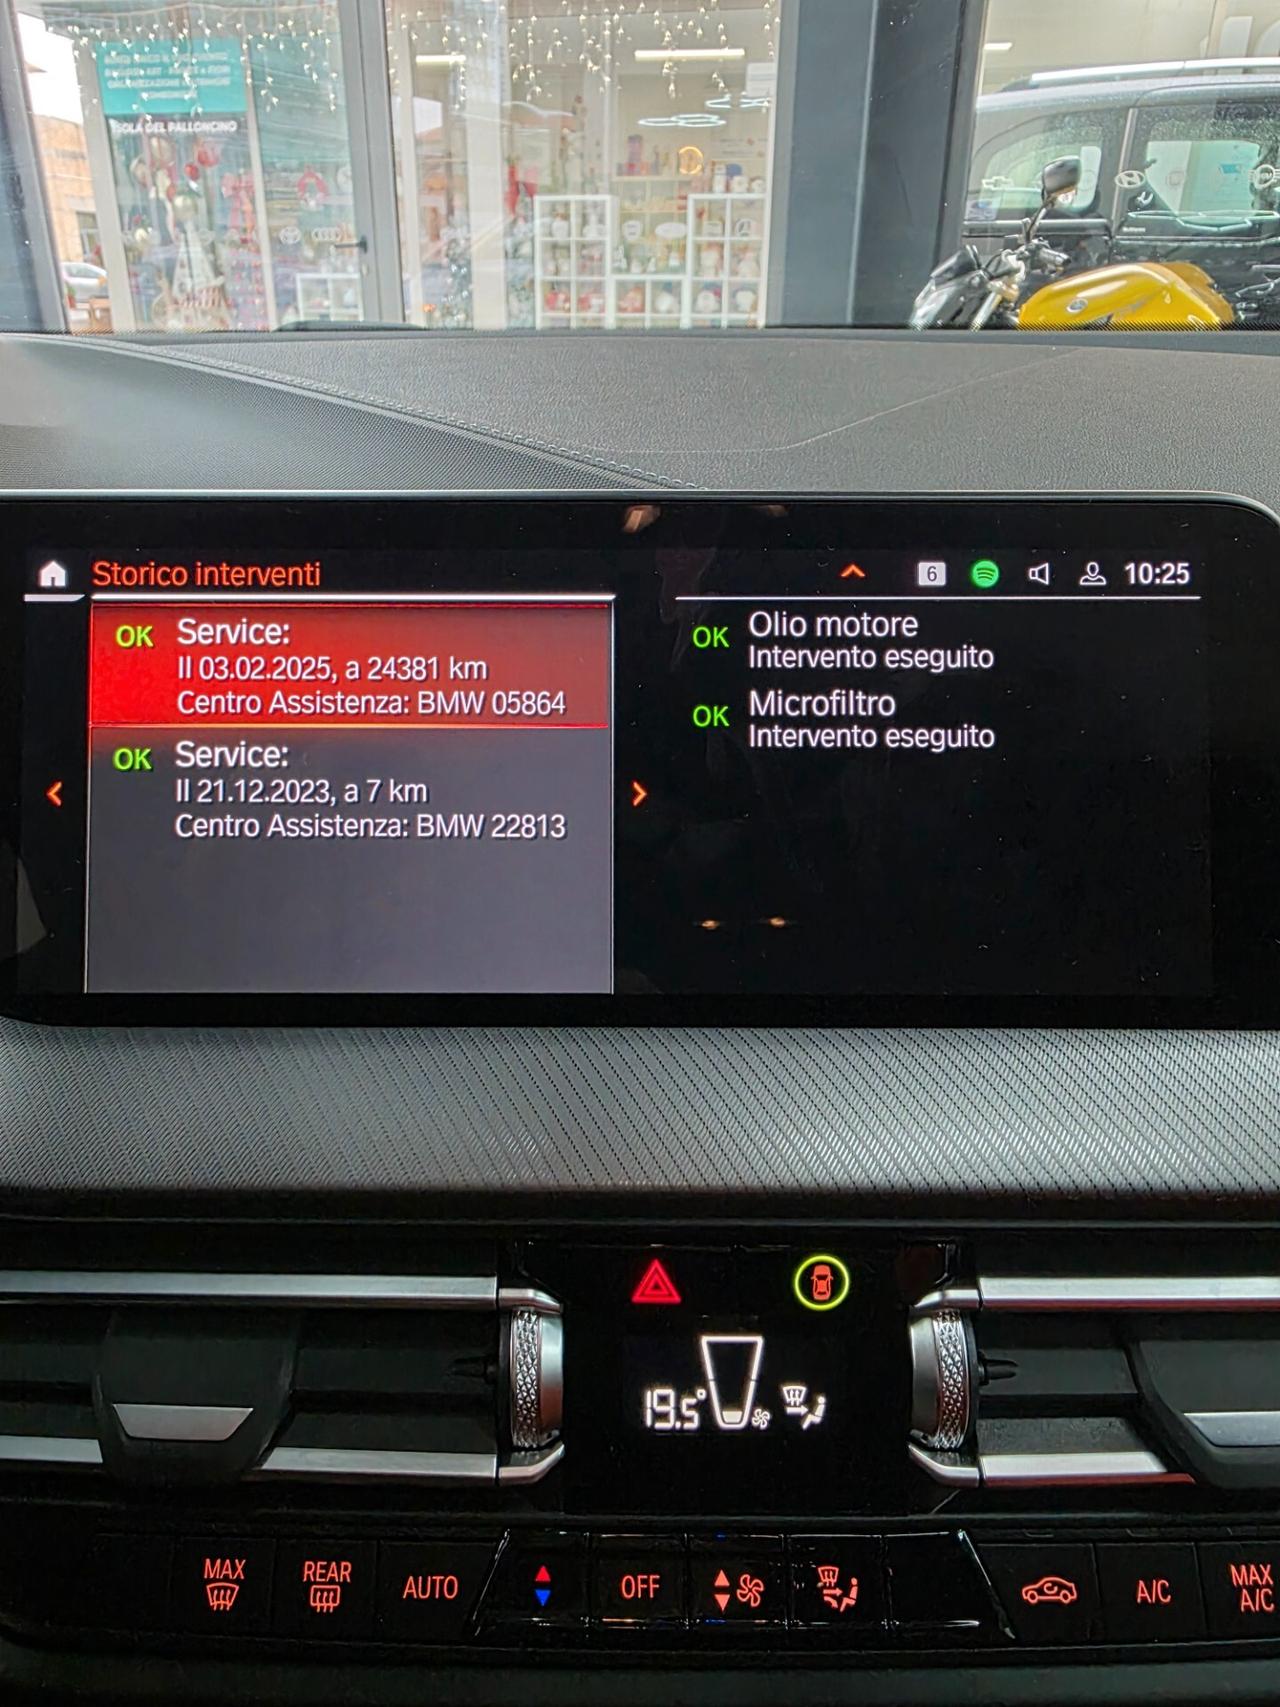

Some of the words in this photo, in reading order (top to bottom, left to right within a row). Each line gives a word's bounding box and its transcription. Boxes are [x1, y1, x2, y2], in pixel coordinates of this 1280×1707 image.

[92, 561, 189, 587] Storico
[195, 561, 321, 587] interventi
[927, 565, 938, 582] 6
[1124, 562, 1191, 585] 10:25
[115, 624, 154, 648] OK
[177, 617, 290, 645] Service:
[749, 610, 808, 638] Olio
[815, 612, 919, 638] motore
[692, 626, 730, 648] OK
[178, 655, 191, 680] Il
[199, 655, 338, 684] 03.02.2025,
[345, 661, 360, 681] a
[367, 656, 439, 681] 24381
[449, 655, 488, 681] km
[749, 644, 877, 669] Intervento
[884, 644, 995, 674] eseguito
[177, 690, 262, 715] Centro
[268, 690, 410, 715] Assistenza:
[418, 691, 486, 715] BMW
[491, 691, 567, 716] 05864
[749, 689, 896, 717] Microfiltro
[692, 704, 730, 728] OK
[749, 723, 878, 748] Intervento
[884, 723, 996, 753] eseguito
[113, 747, 152, 771] OK
[175, 740, 289, 768] Service:
[176, 778, 190, 803] Il
[196, 778, 337, 807] 21.12.2023,
[343, 784, 360, 803] a
[366, 778, 382, 803] 7
[389, 778, 428, 803] km
[175, 813, 260, 838] Centro
[266, 812, 409, 838] Assistenza:
[416, 813, 486, 838] BMW
[490, 813, 567, 839] 22813
[203, 1558, 246, 1580] MAX
[303, 1560, 352, 1583] REAR
[1230, 1564, 1274, 1587] MAX
[402, 1575, 459, 1600] AUTO
[621, 1574, 660, 1599] OFF
[1136, 1579, 1172, 1605] A/C
[1241, 1588, 1275, 1613] A/C
